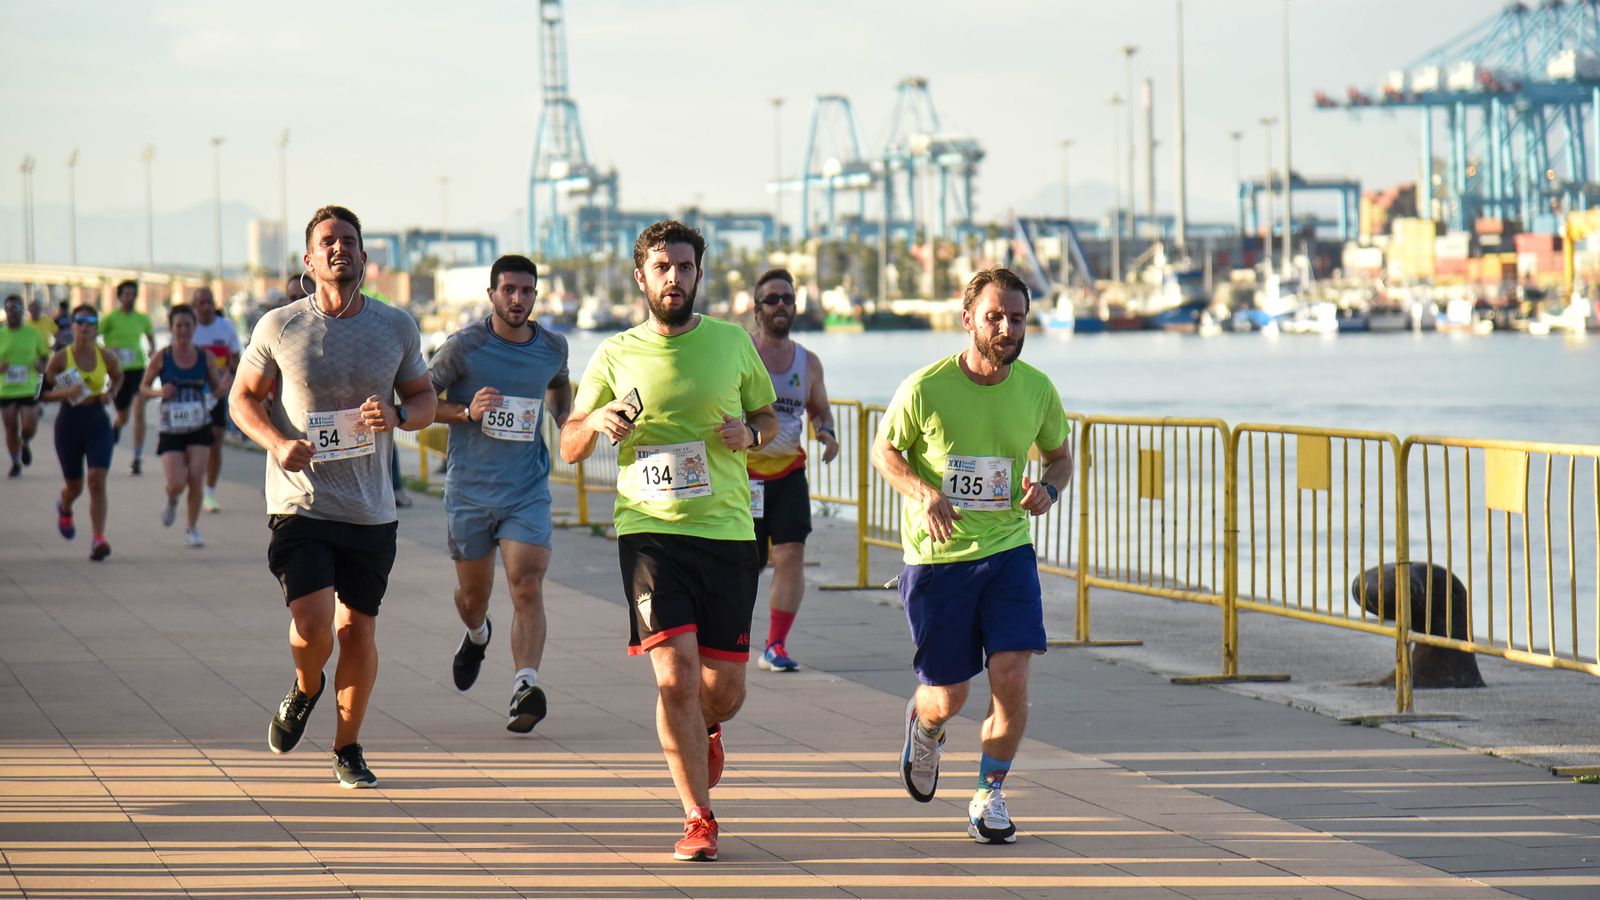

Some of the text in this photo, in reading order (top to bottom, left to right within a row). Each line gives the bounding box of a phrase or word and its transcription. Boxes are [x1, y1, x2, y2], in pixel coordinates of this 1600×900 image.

[488, 411, 515, 427] 558
[319, 429, 340, 447] 54
[948, 460, 961, 468] XXI
[643, 465, 672, 485] 134
[950, 474, 983, 495] 135
